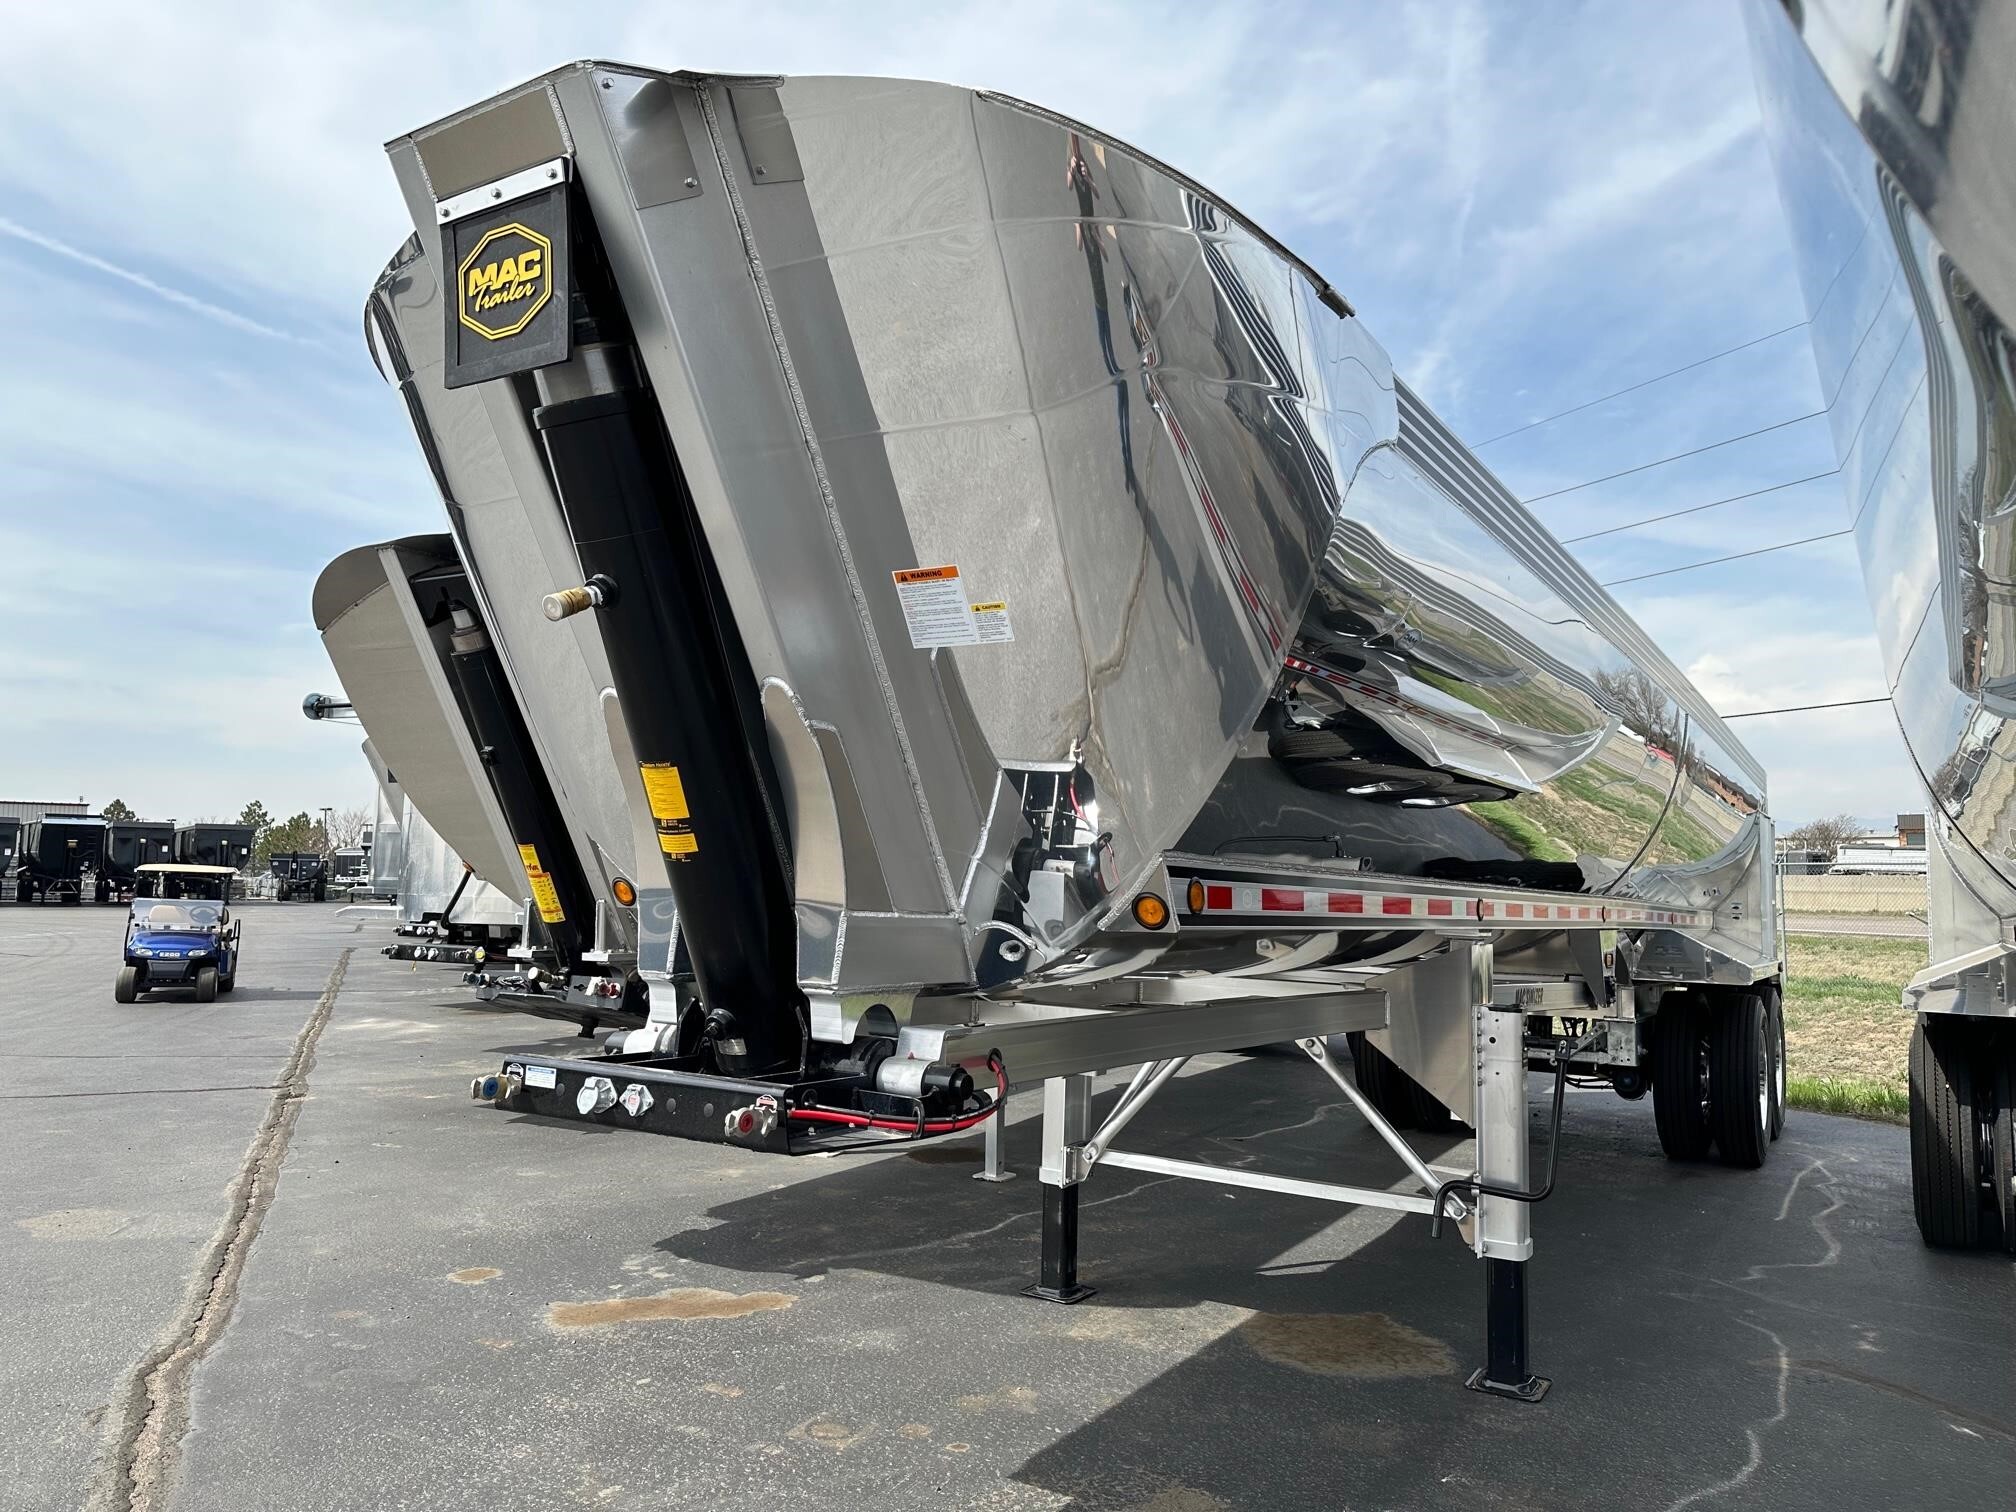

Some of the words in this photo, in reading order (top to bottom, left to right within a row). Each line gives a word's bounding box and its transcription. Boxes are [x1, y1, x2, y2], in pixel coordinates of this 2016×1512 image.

[469, 249, 541, 297] MAC
[473, 275, 536, 312] Trailer
[910, 570, 942, 579] WARNING
